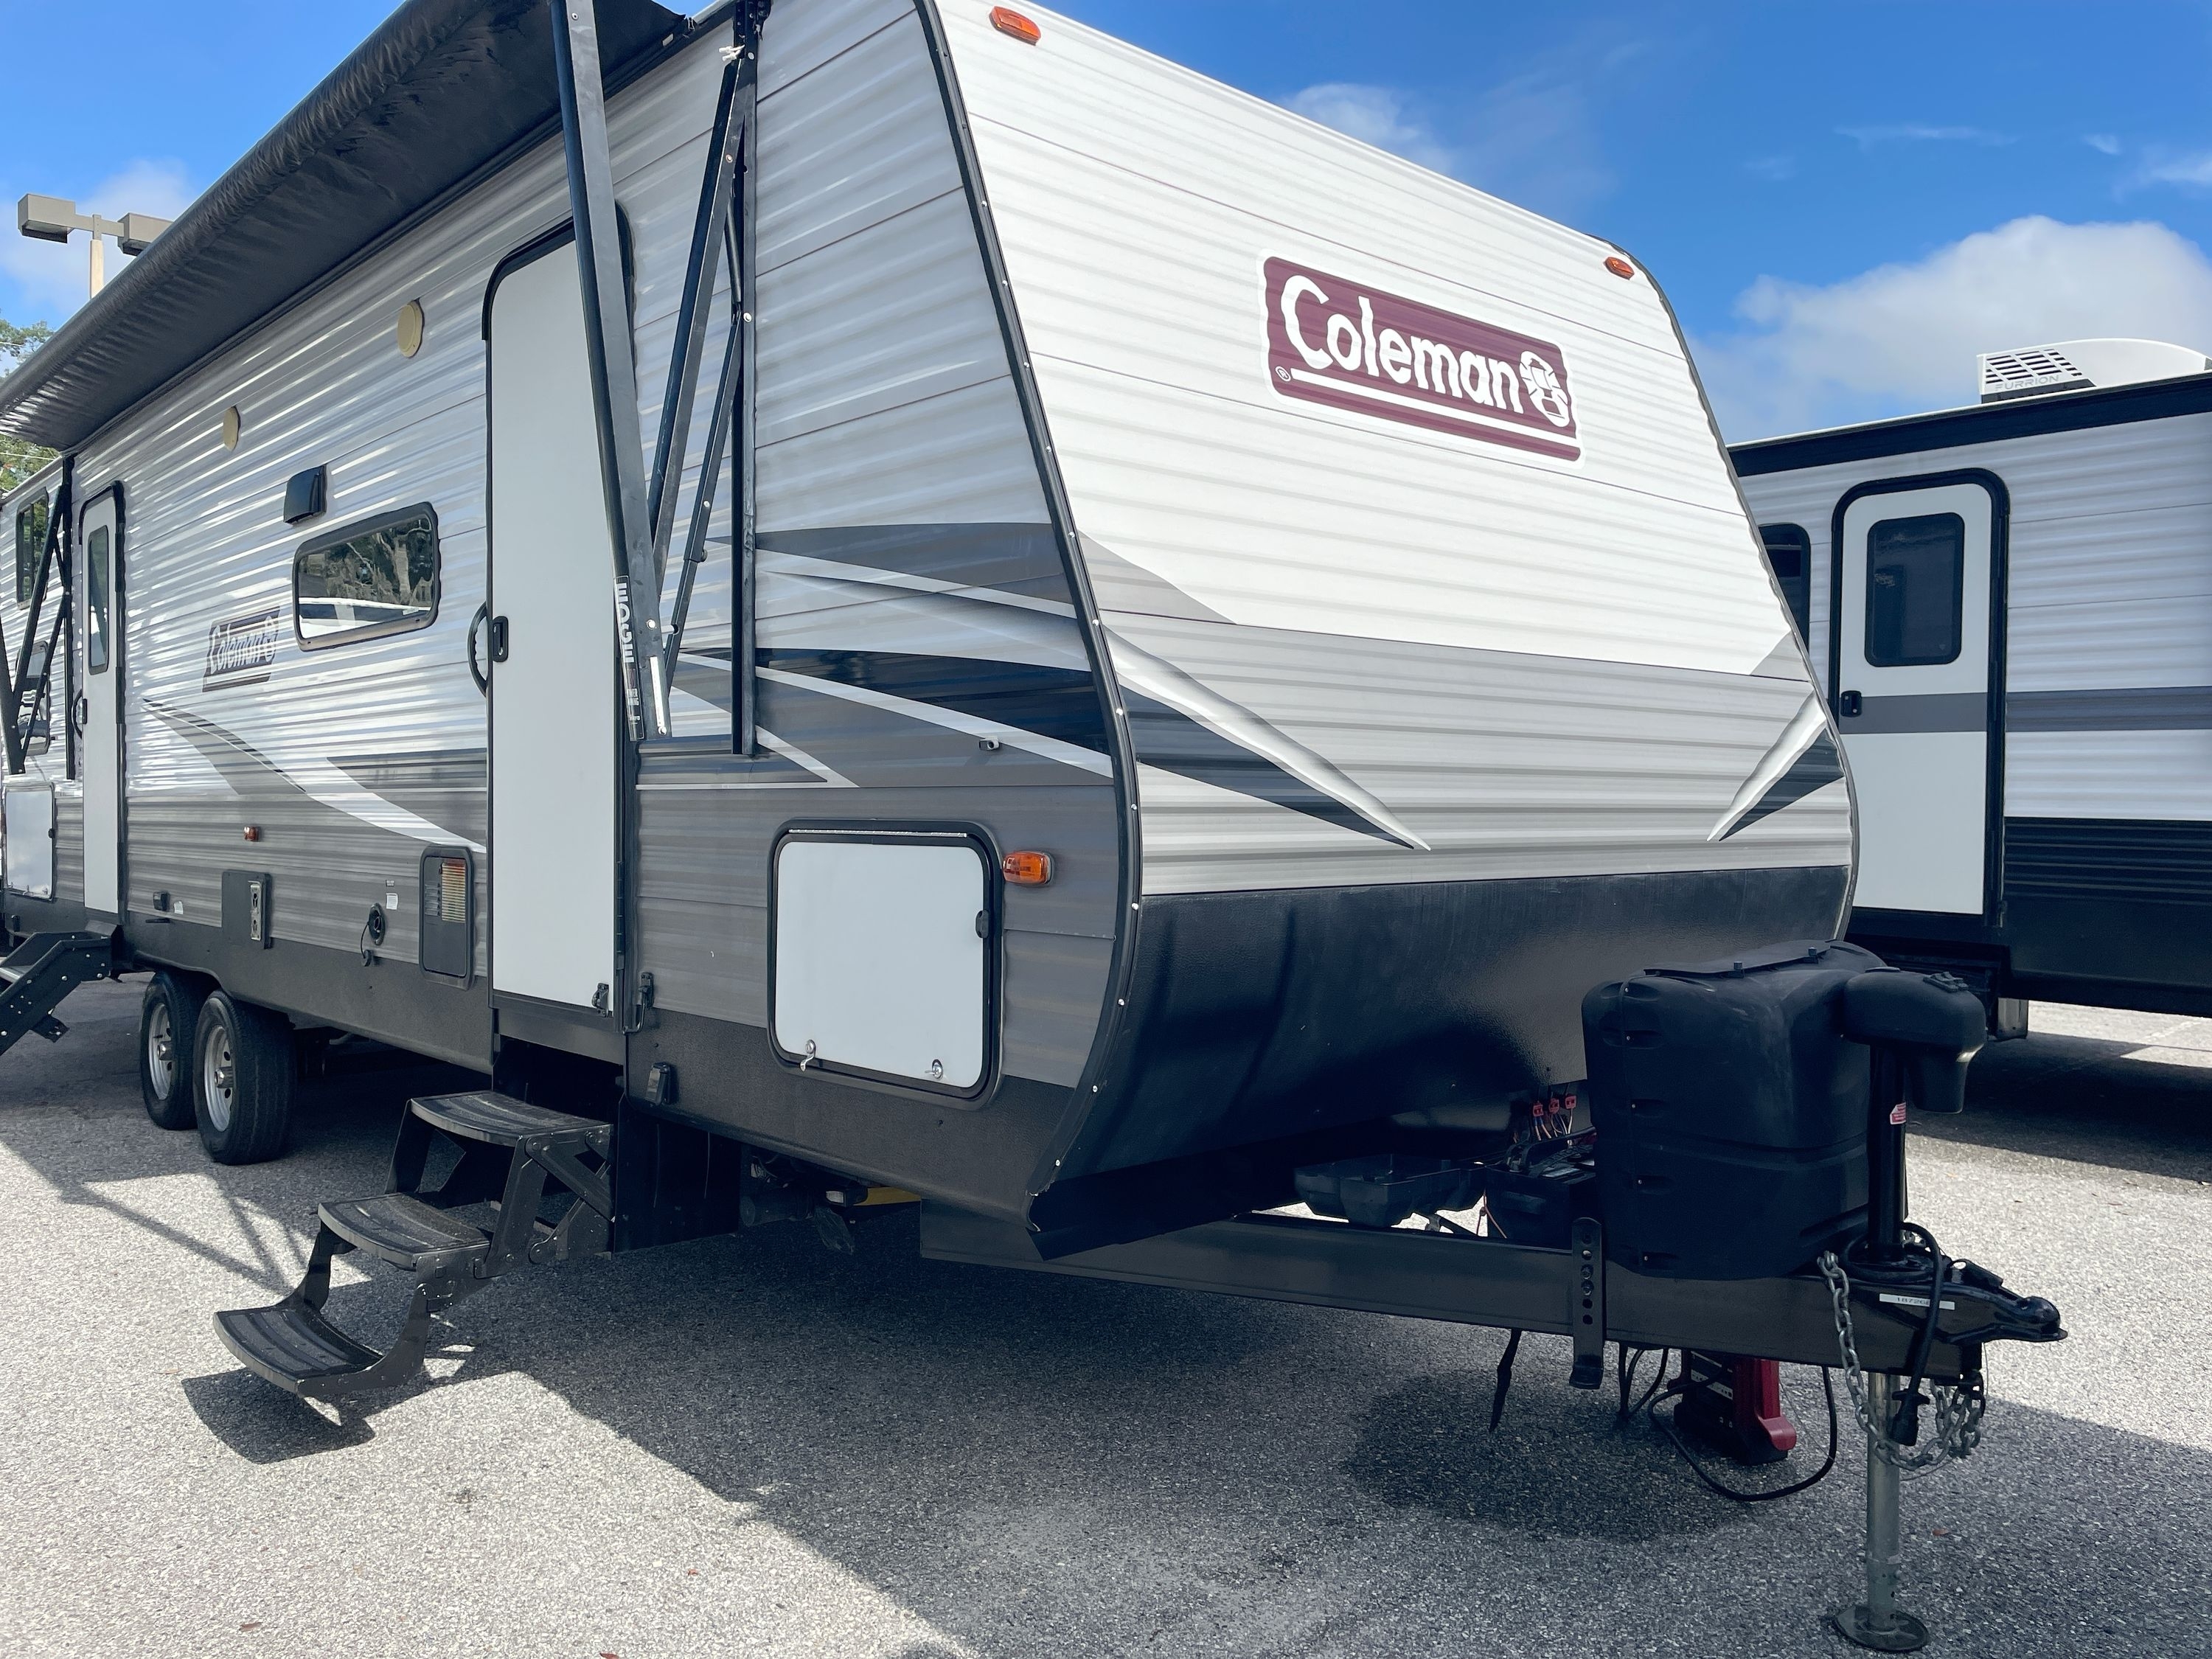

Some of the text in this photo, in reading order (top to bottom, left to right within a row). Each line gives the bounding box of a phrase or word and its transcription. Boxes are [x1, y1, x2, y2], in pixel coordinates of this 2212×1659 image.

[1281, 275, 1525, 414] Coleman
[1994, 375, 2059, 392] FURRION
[209, 623, 263, 674] Coleman
